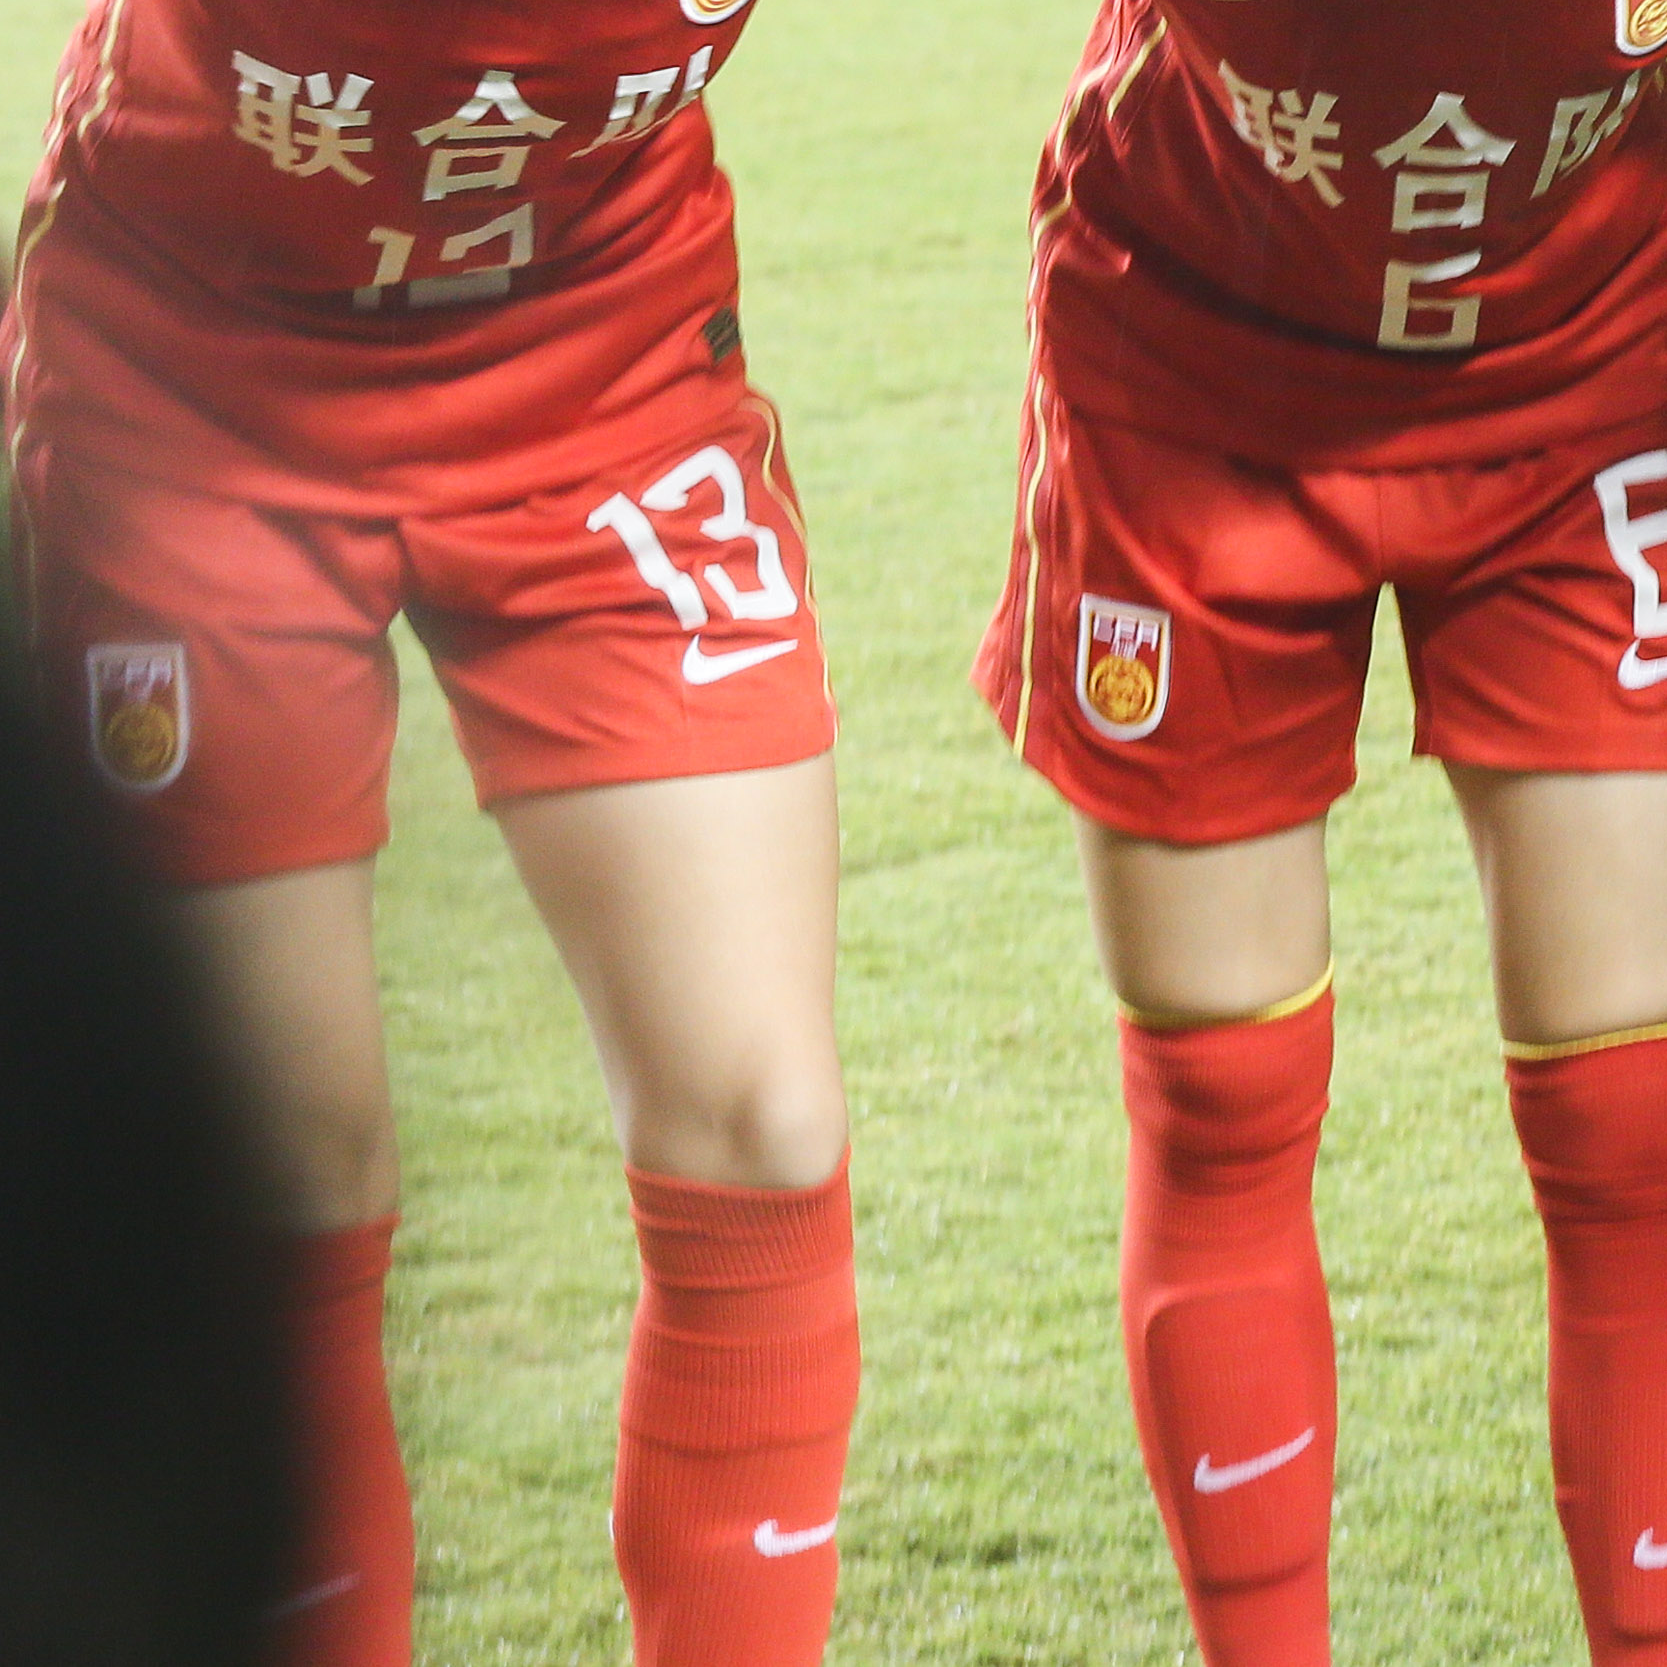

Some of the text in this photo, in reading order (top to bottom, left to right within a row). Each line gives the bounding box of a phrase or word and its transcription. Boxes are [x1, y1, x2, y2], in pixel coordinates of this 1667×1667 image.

[1218, 58, 1640, 233] 联合队
[1377, 248, 1482, 350] 6
[587, 445, 797, 631] 13
